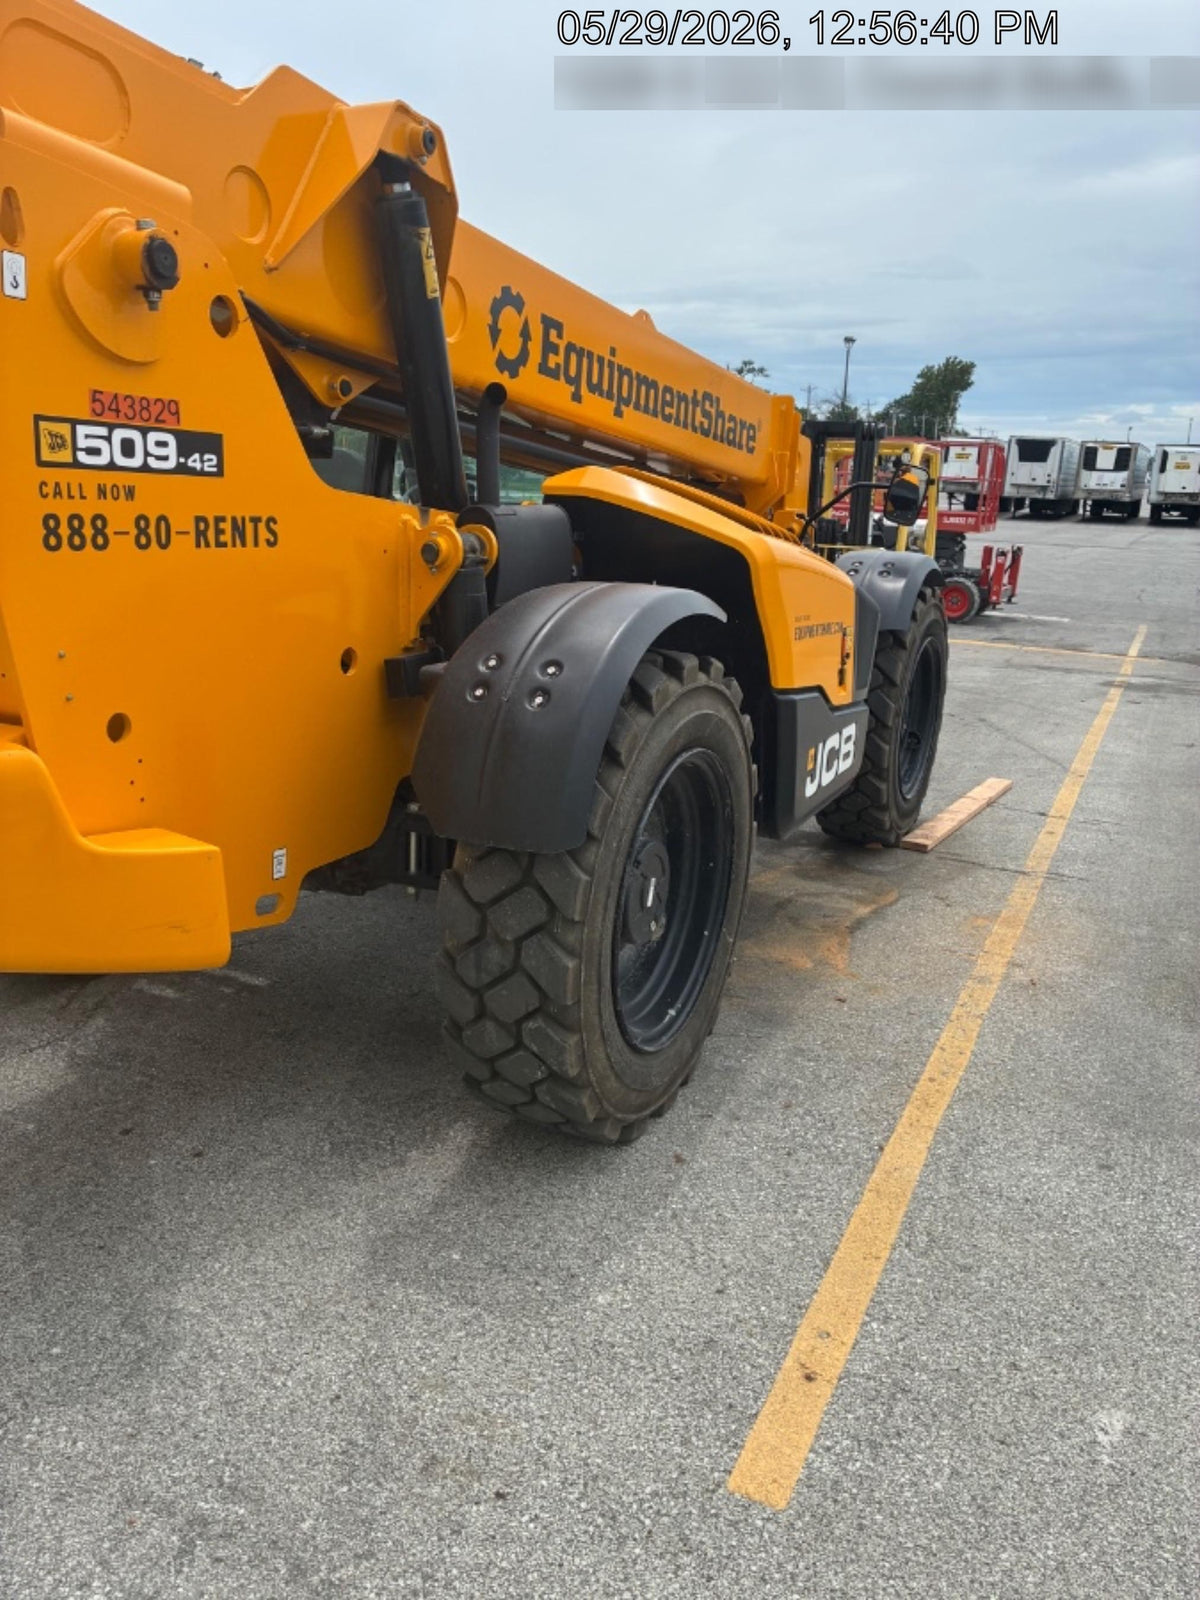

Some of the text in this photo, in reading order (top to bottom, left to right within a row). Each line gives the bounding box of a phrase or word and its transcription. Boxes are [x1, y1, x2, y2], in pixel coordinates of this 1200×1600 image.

[538, 312, 757, 454] EquipmentShare
[91, 389, 181, 425] 543829
[75, 424, 218, 472] 509-42
[38, 480, 137, 501] CALL NOW
[41, 512, 279, 552] 888-80-RENTS
[805, 722, 856, 798] JCB
